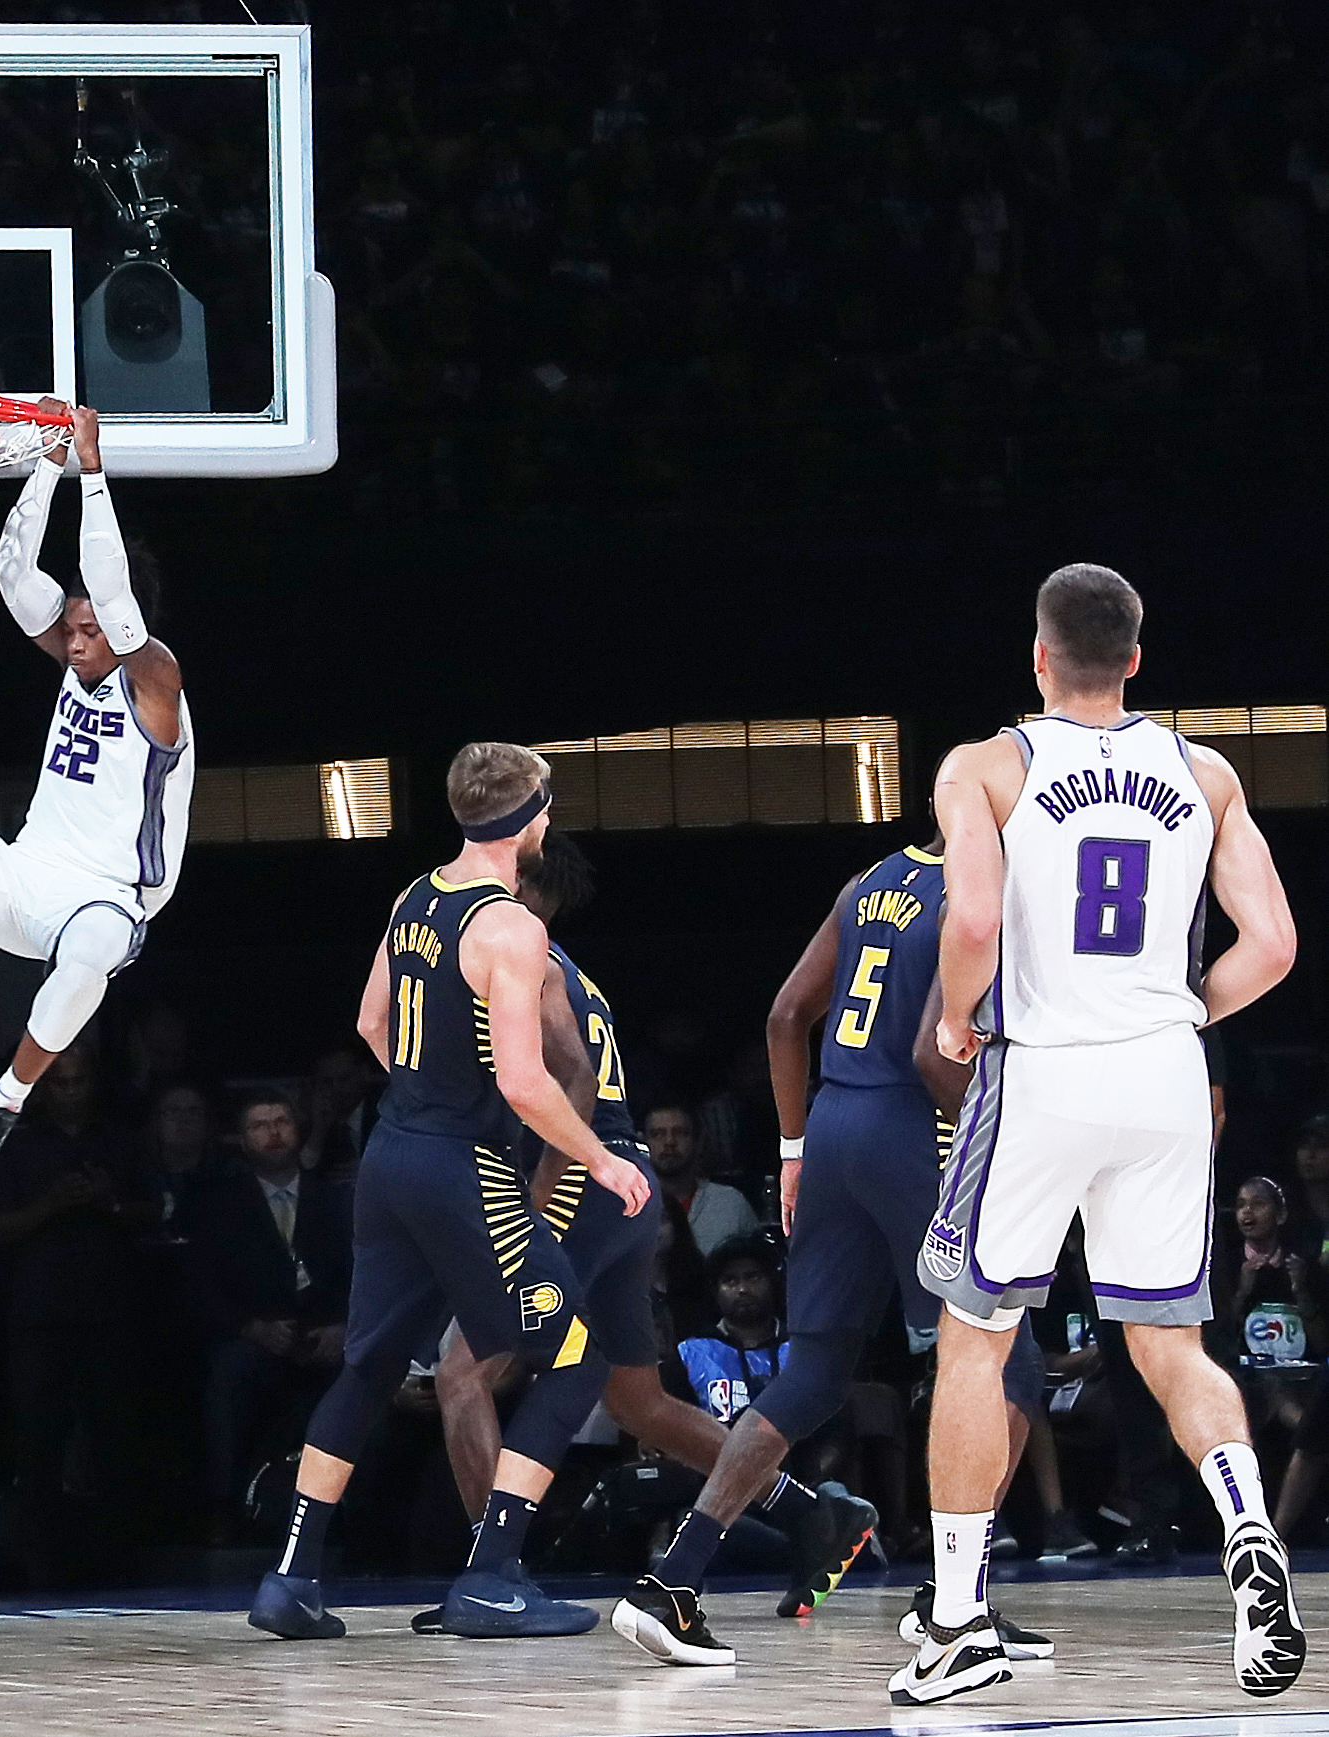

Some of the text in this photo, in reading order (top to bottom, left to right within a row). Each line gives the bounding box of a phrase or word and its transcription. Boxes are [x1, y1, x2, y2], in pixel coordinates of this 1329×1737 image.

[46, 725, 100, 785] 22
[1073, 836, 1151, 957] 8
[393, 922, 443, 969] SABONIS
[394, 974, 424, 1071] 11
[835, 945, 891, 1049] 5
[926, 1232, 962, 1262] SAC
